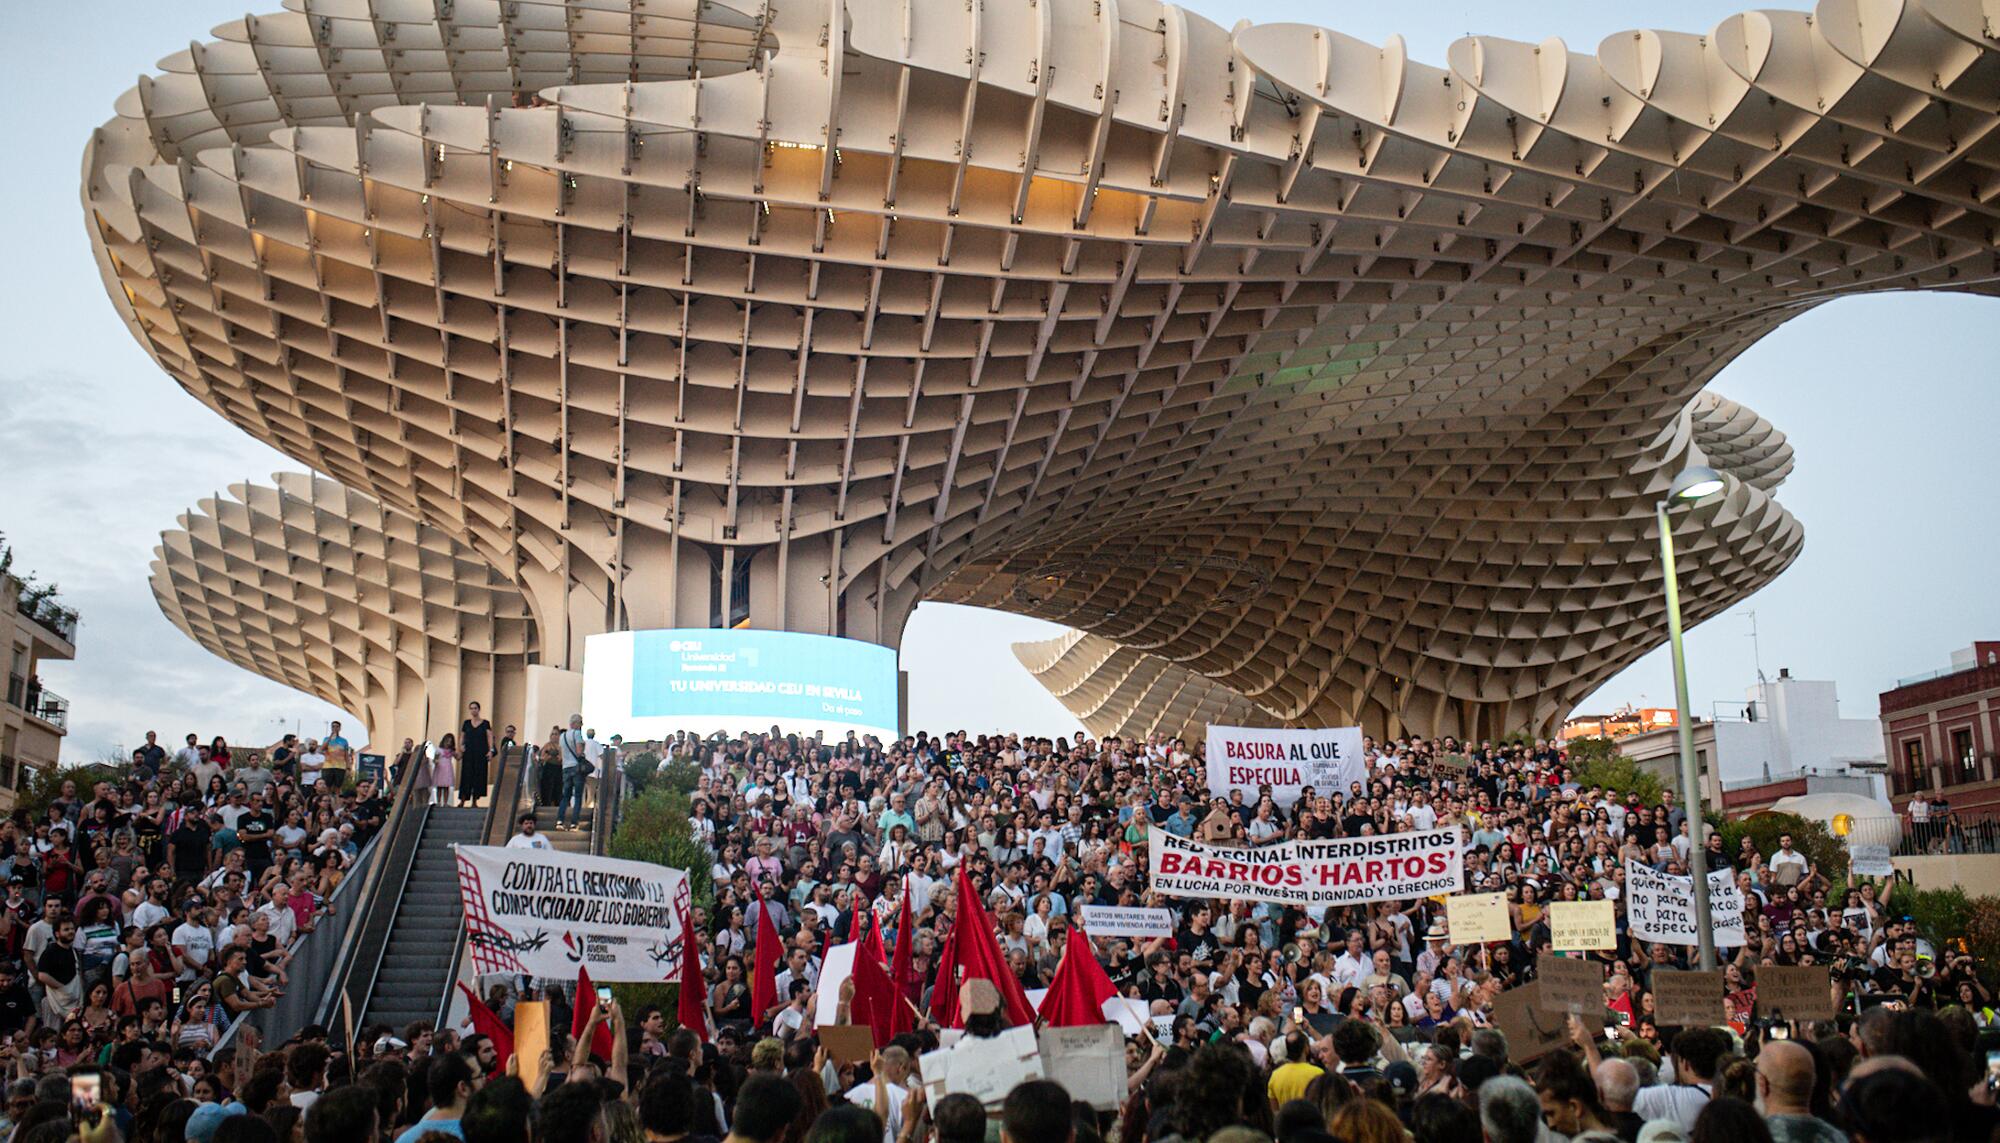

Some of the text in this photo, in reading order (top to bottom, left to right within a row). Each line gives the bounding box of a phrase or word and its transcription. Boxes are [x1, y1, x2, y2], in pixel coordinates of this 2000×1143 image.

[682, 653, 736, 662] Universidad
[670, 680, 862, 701] TU UNIVERSIDAD CEU EN SEVILLA
[1226, 741, 1341, 761] BASURA AL QUE
[1229, 766, 1302, 786] ESPECULA
[1296, 832, 1455, 860] INTERDISTRITOS
[1159, 852, 1303, 886] BARRIOS
[502, 861, 665, 904] CONTRA EL RENTISMO Y LA
[1155, 878, 1173, 889] EN
[1176, 878, 1220, 891] LUCHA
[1224, 882, 1251, 894] POR
[1312, 887, 1374, 901] DIGNIDAD
[1377, 886, 1385, 897] Y
[1388, 877, 1455, 896] DERECHOS
[1631, 877, 1666, 890] quien
[492, 890, 585, 922] COMPLICIDAD
[584, 899, 603, 923] DE
[602, 900, 623, 925] LOS
[1632, 893, 1649, 905] no
[1657, 894, 1688, 907] para
[1090, 911, 1113, 919] GASTOS
[1633, 908, 1688, 923] ni para
